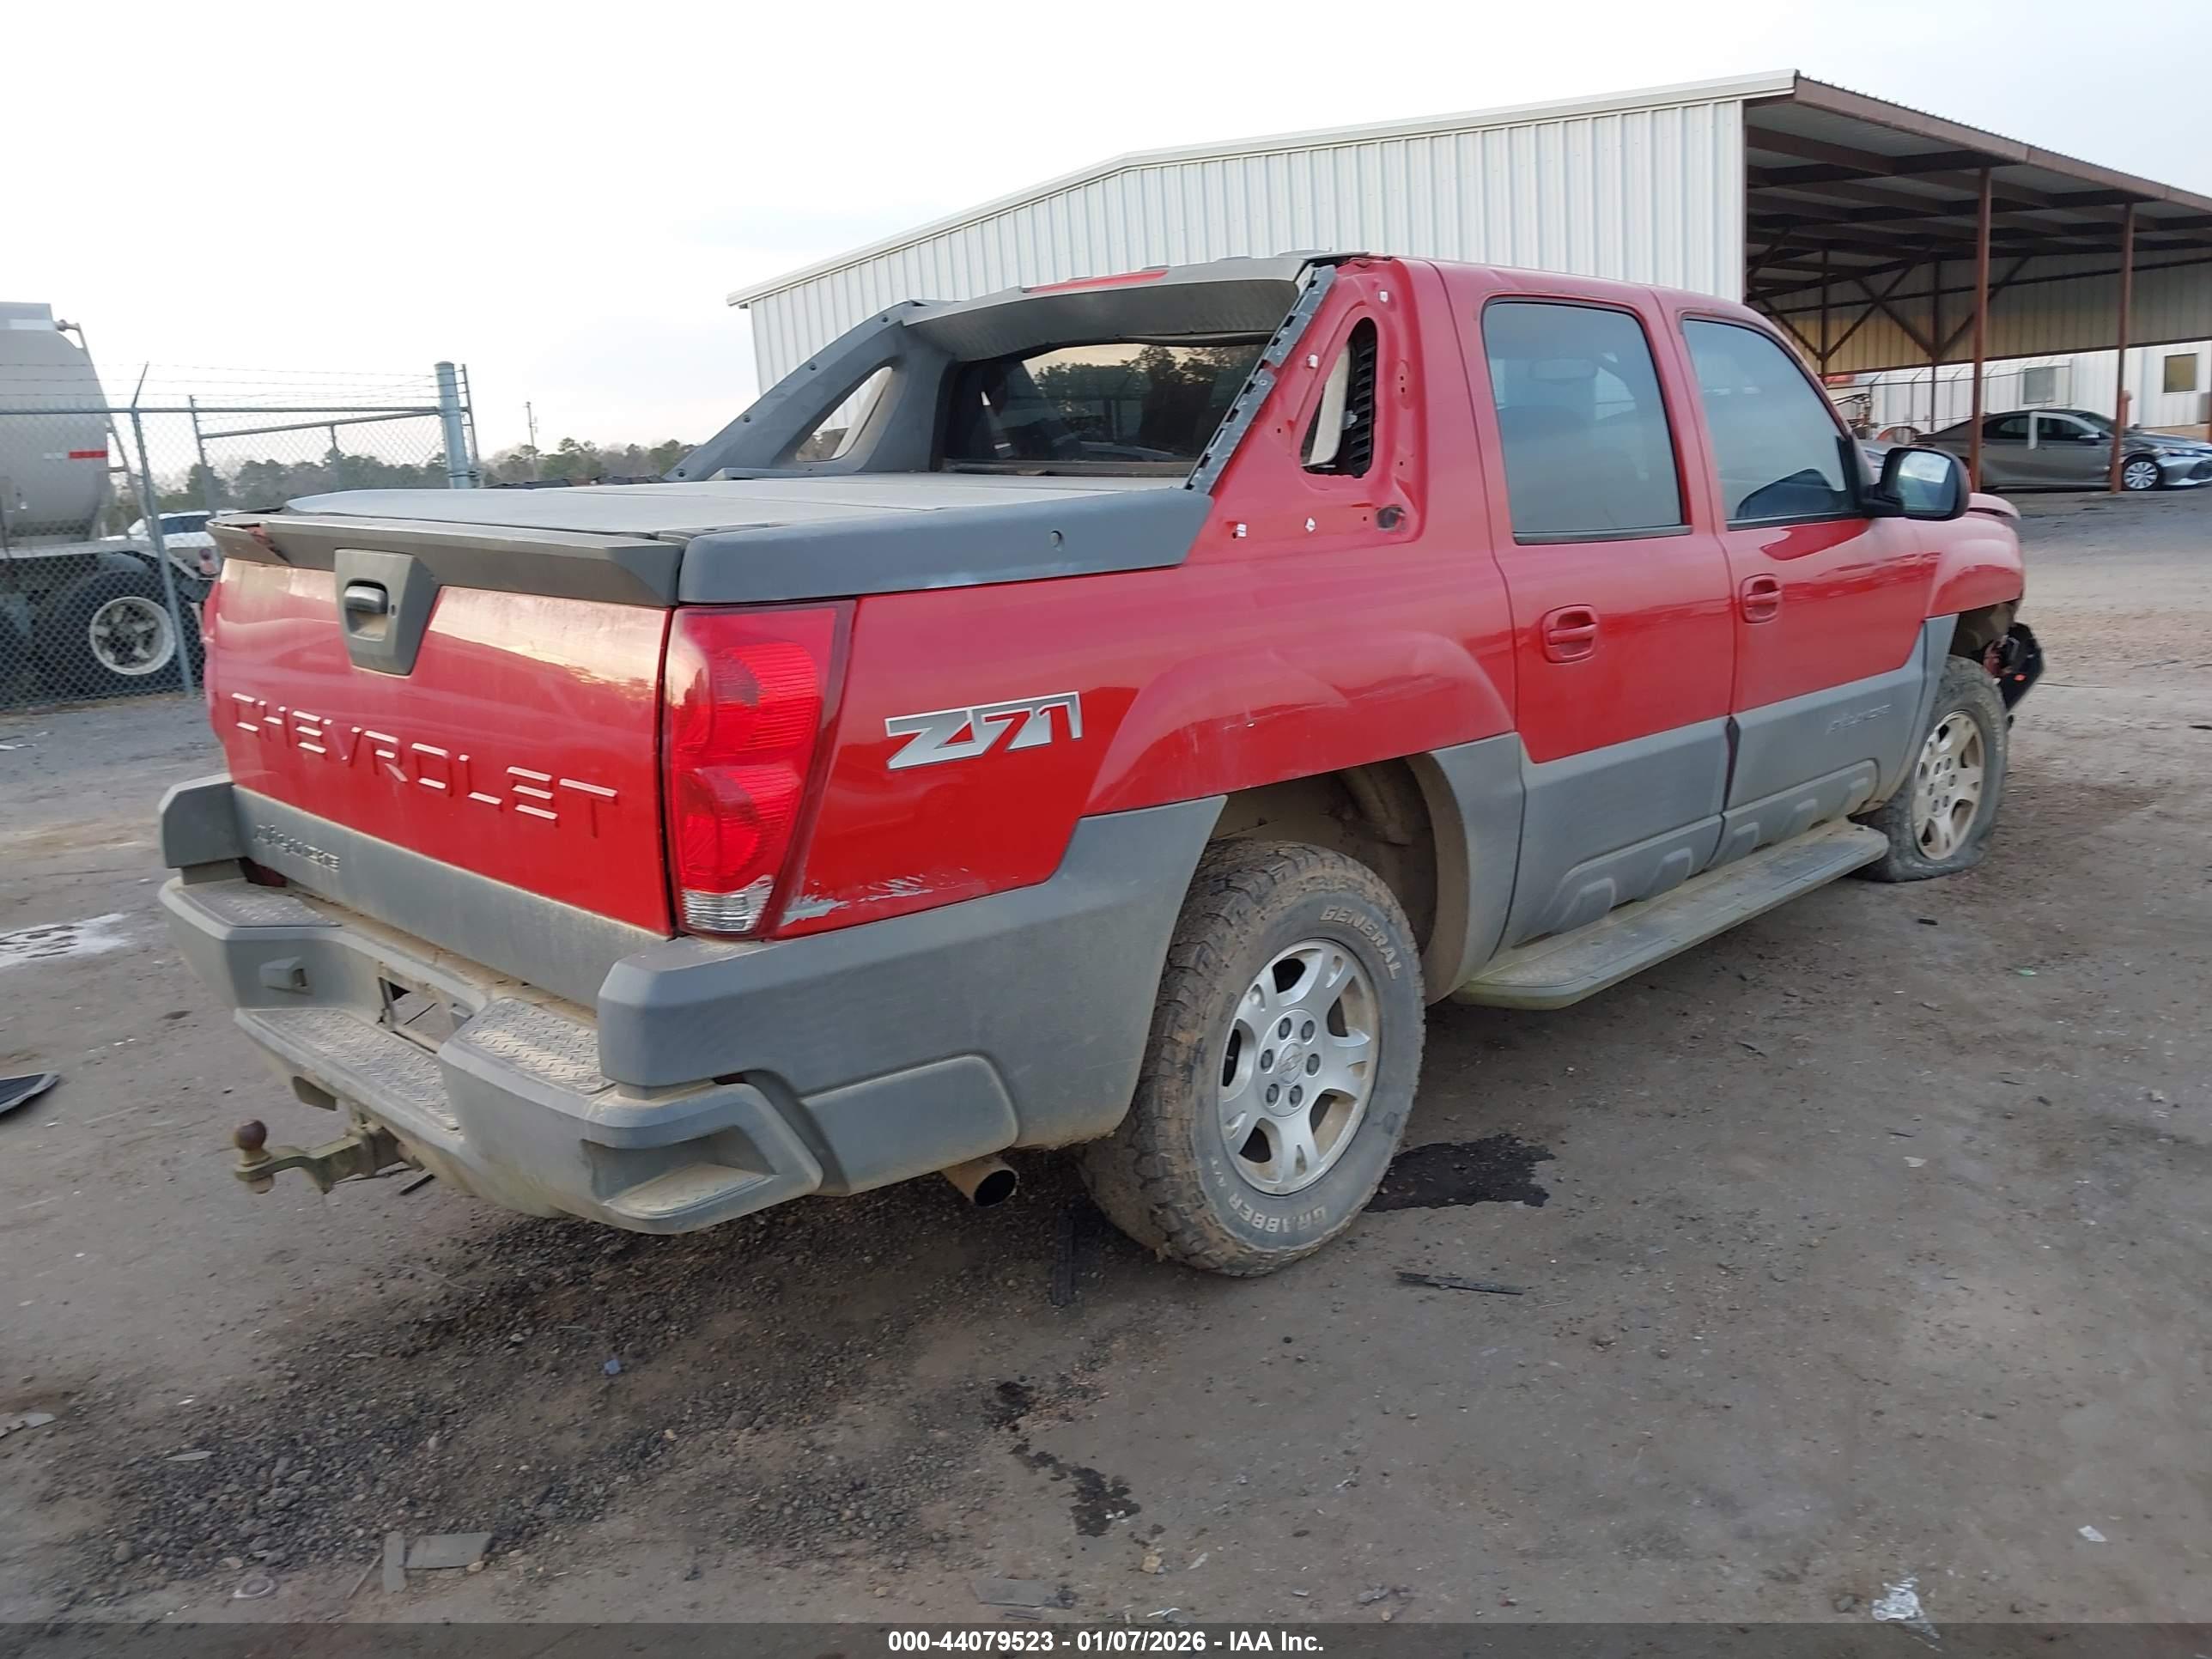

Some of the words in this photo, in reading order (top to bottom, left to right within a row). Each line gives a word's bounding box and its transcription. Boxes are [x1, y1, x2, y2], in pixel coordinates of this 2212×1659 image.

[231, 692, 618, 838] CHEVROLET
[884, 690, 1083, 770] Z71
[1319, 906, 1401, 980] GENERAL
[1228, 1193, 1327, 1234] GRABBER
